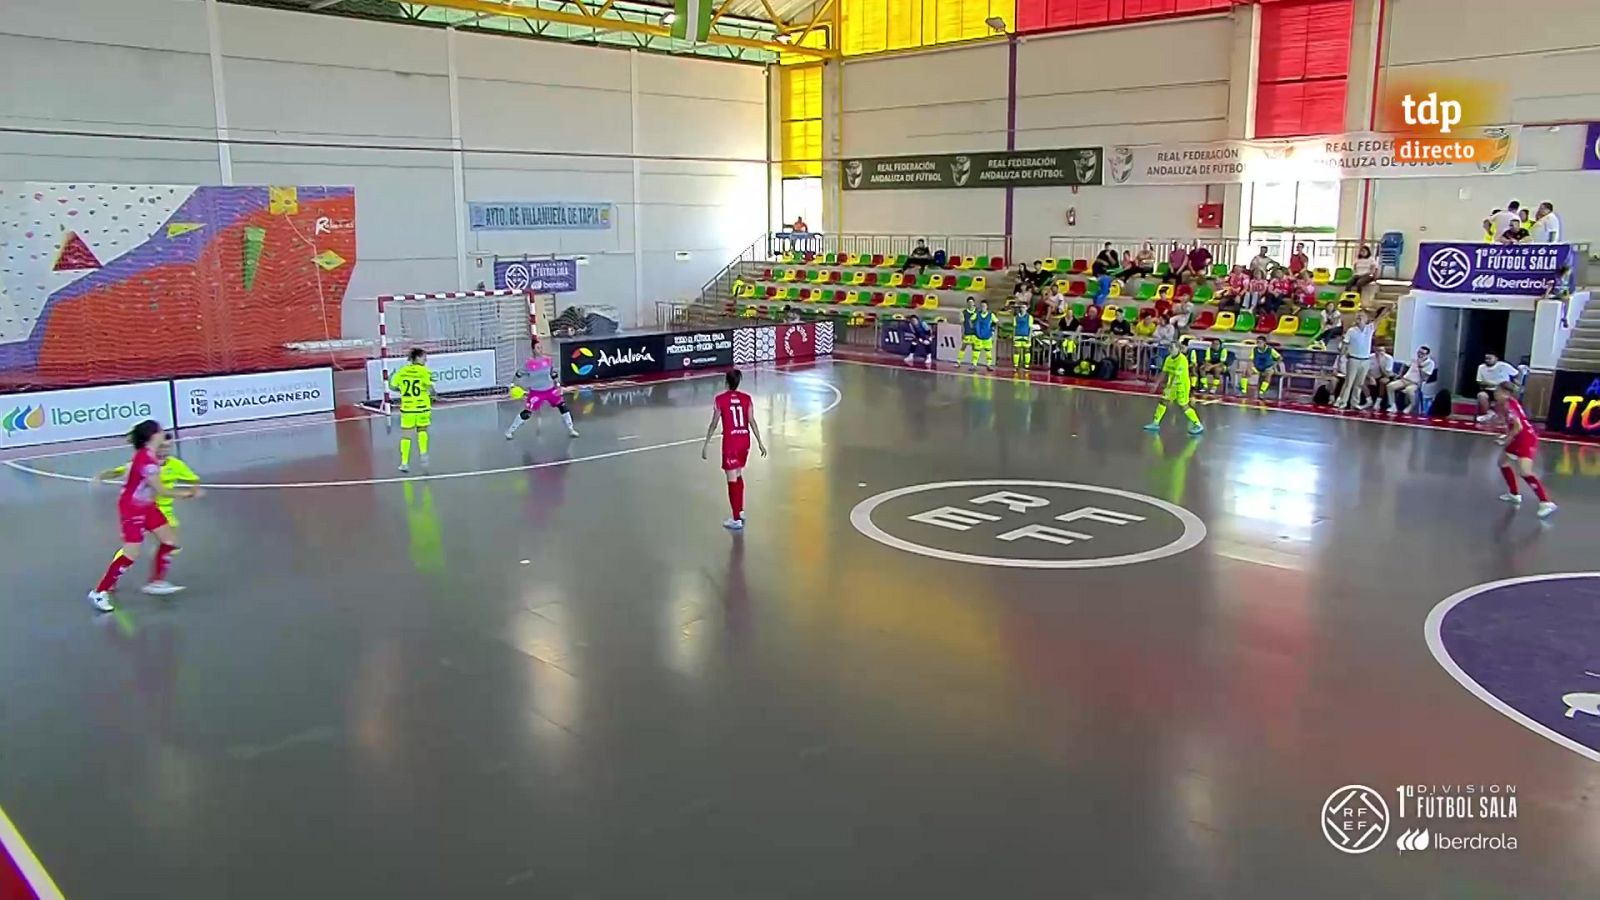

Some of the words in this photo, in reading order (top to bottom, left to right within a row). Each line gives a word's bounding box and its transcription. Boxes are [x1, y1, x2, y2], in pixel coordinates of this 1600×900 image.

[1325, 142, 1353, 152] REAL
[1157, 152, 1180, 161] REAL
[1183, 148, 1239, 160] FEDERACIÓN
[877, 163, 893, 171] REAL
[894, 161, 936, 171] FEDERACIÓN
[988, 159, 1006, 168] REAL
[1008, 157, 1056, 167] FEDERACIÓN
[980, 171, 1020, 180] ANDALUZA
[1021, 170, 1031, 178] DE
[1033, 168, 1064, 178] FÚTBOL
[1147, 164, 1197, 175] ANDALUZA
[1199, 164, 1210, 174] DE
[870, 174, 904, 182] ANDALUZA
[509, 207, 520, 225] DE
[521, 206, 567, 225] VILLANUEVA
[567, 207, 577, 224] DE
[578, 207, 599, 224] TAPIA
[1529, 256, 1556, 270] SALA
[1496, 277, 1549, 288] Iberdrol
[430, 364, 482, 382] erdrola
[402, 379, 421, 397] 26
[214, 389, 320, 409] NAVALCARNERO
[51, 401, 151, 425] Iberdrola
[730, 405, 744, 427] 11
